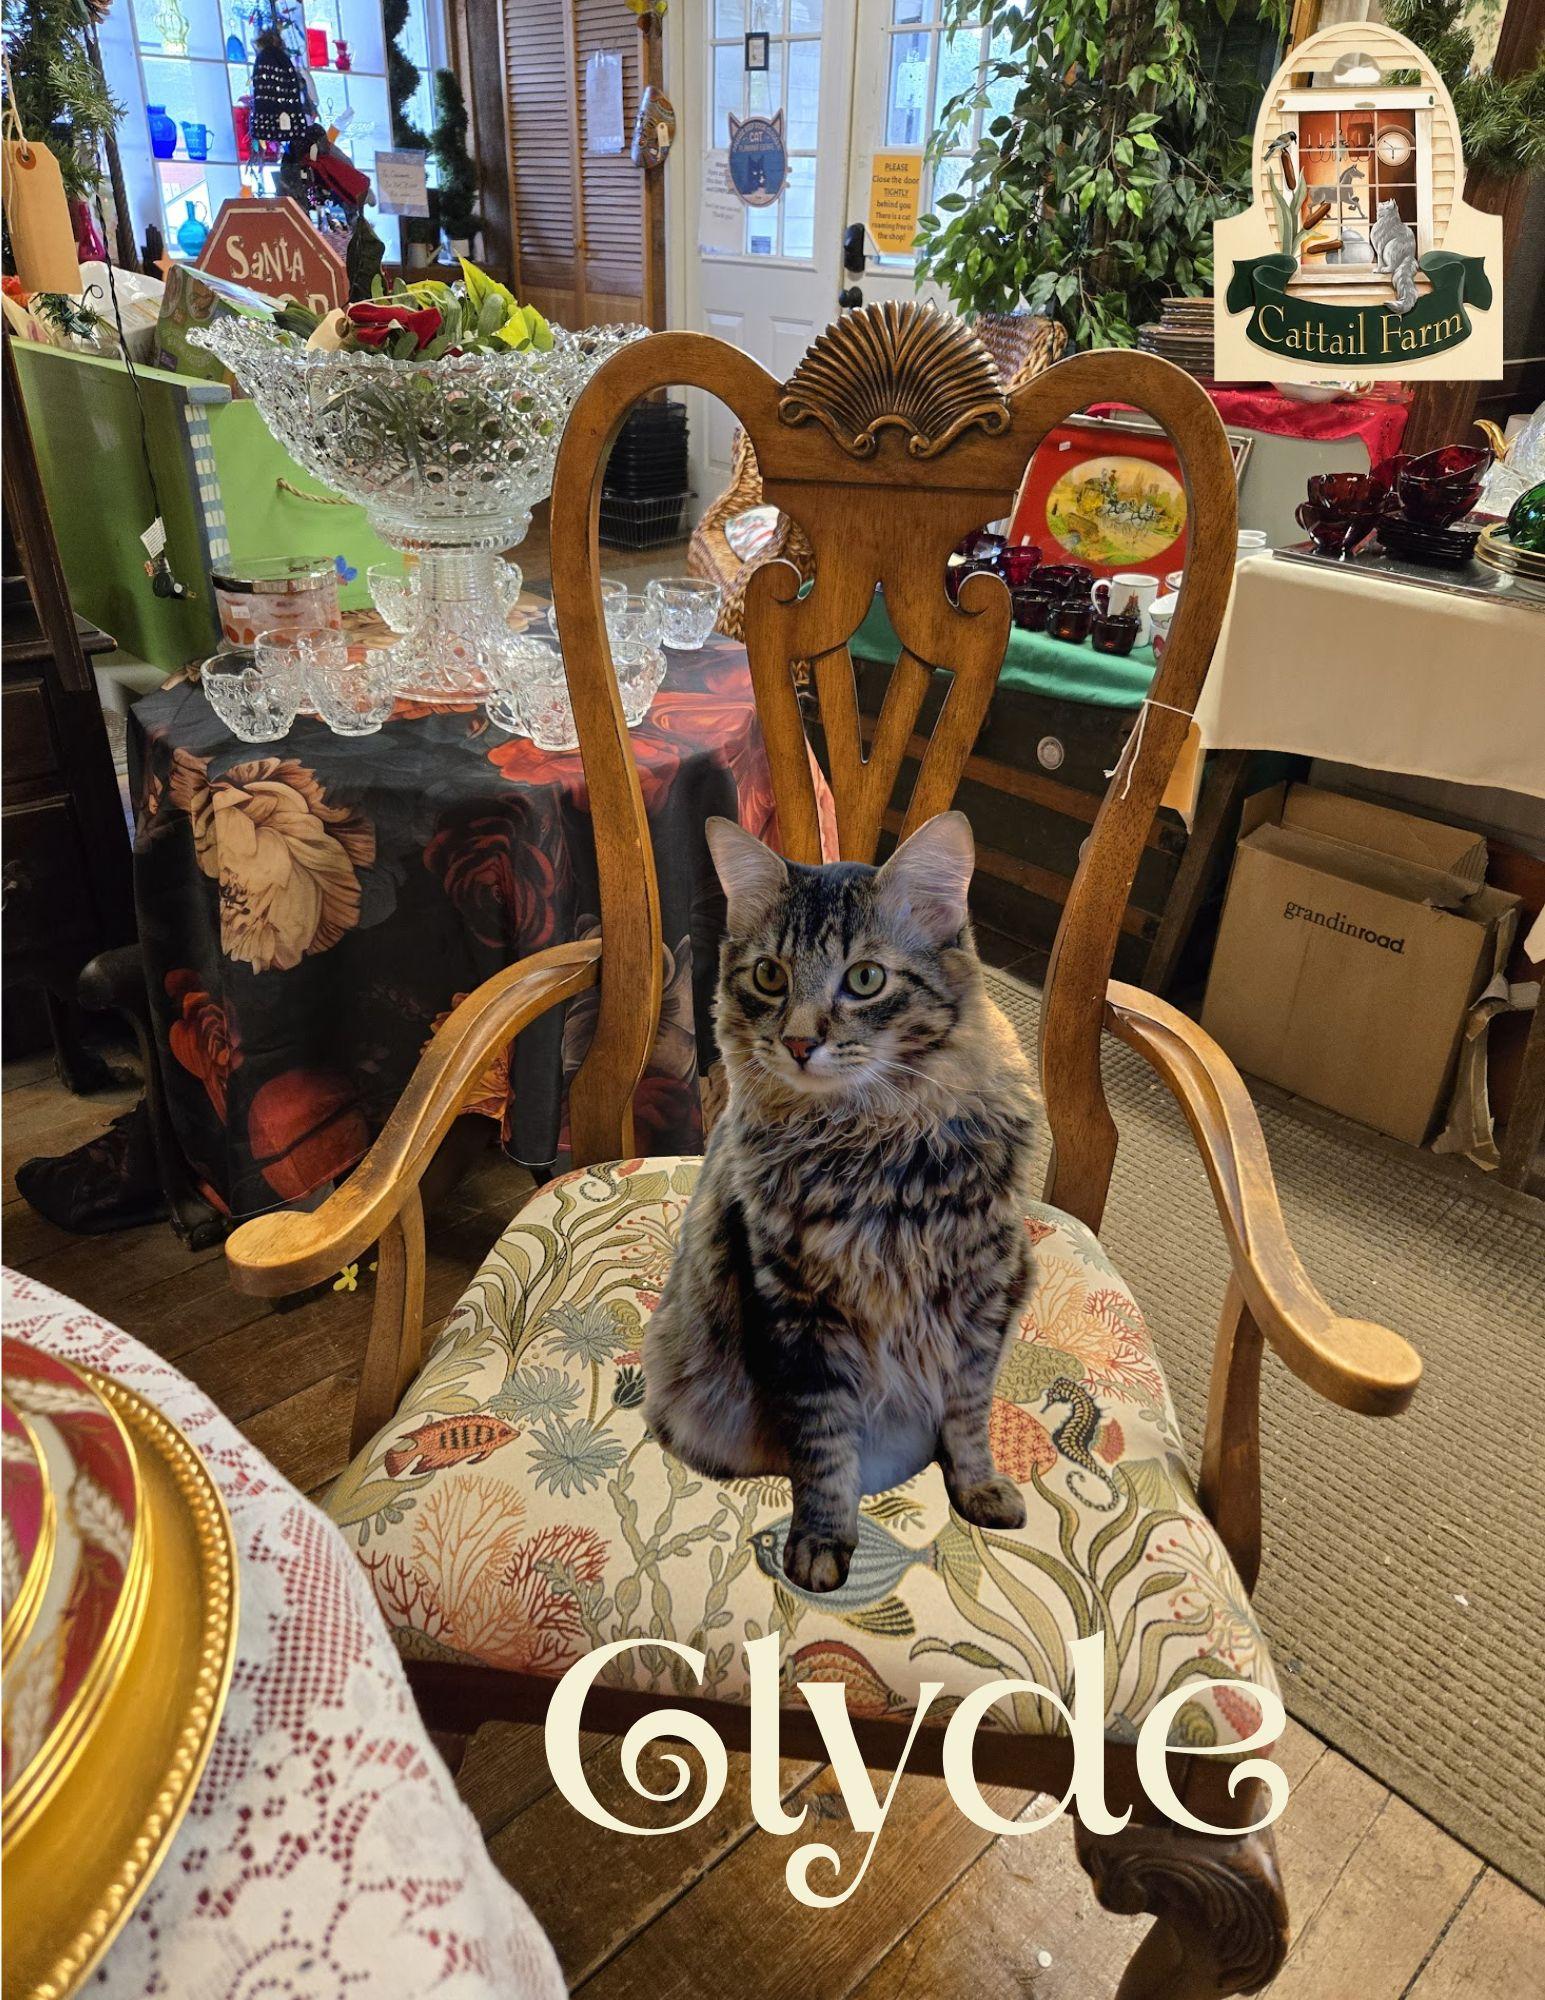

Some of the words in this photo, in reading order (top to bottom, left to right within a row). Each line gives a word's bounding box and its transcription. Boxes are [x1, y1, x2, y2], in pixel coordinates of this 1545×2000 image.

[749, 131, 763, 142] CAT
[884, 162, 909, 172] PLEASE
[872, 175, 890, 184] Close
[891, 175, 902, 184] the
[903, 176, 920, 184] door
[883, 187, 909, 197] TIGHTLY
[876, 200, 898, 209] behind
[899, 202, 911, 211] you
[875, 211, 891, 219] There
[871, 222, 895, 231] roaming
[877, 231, 888, 240] the
